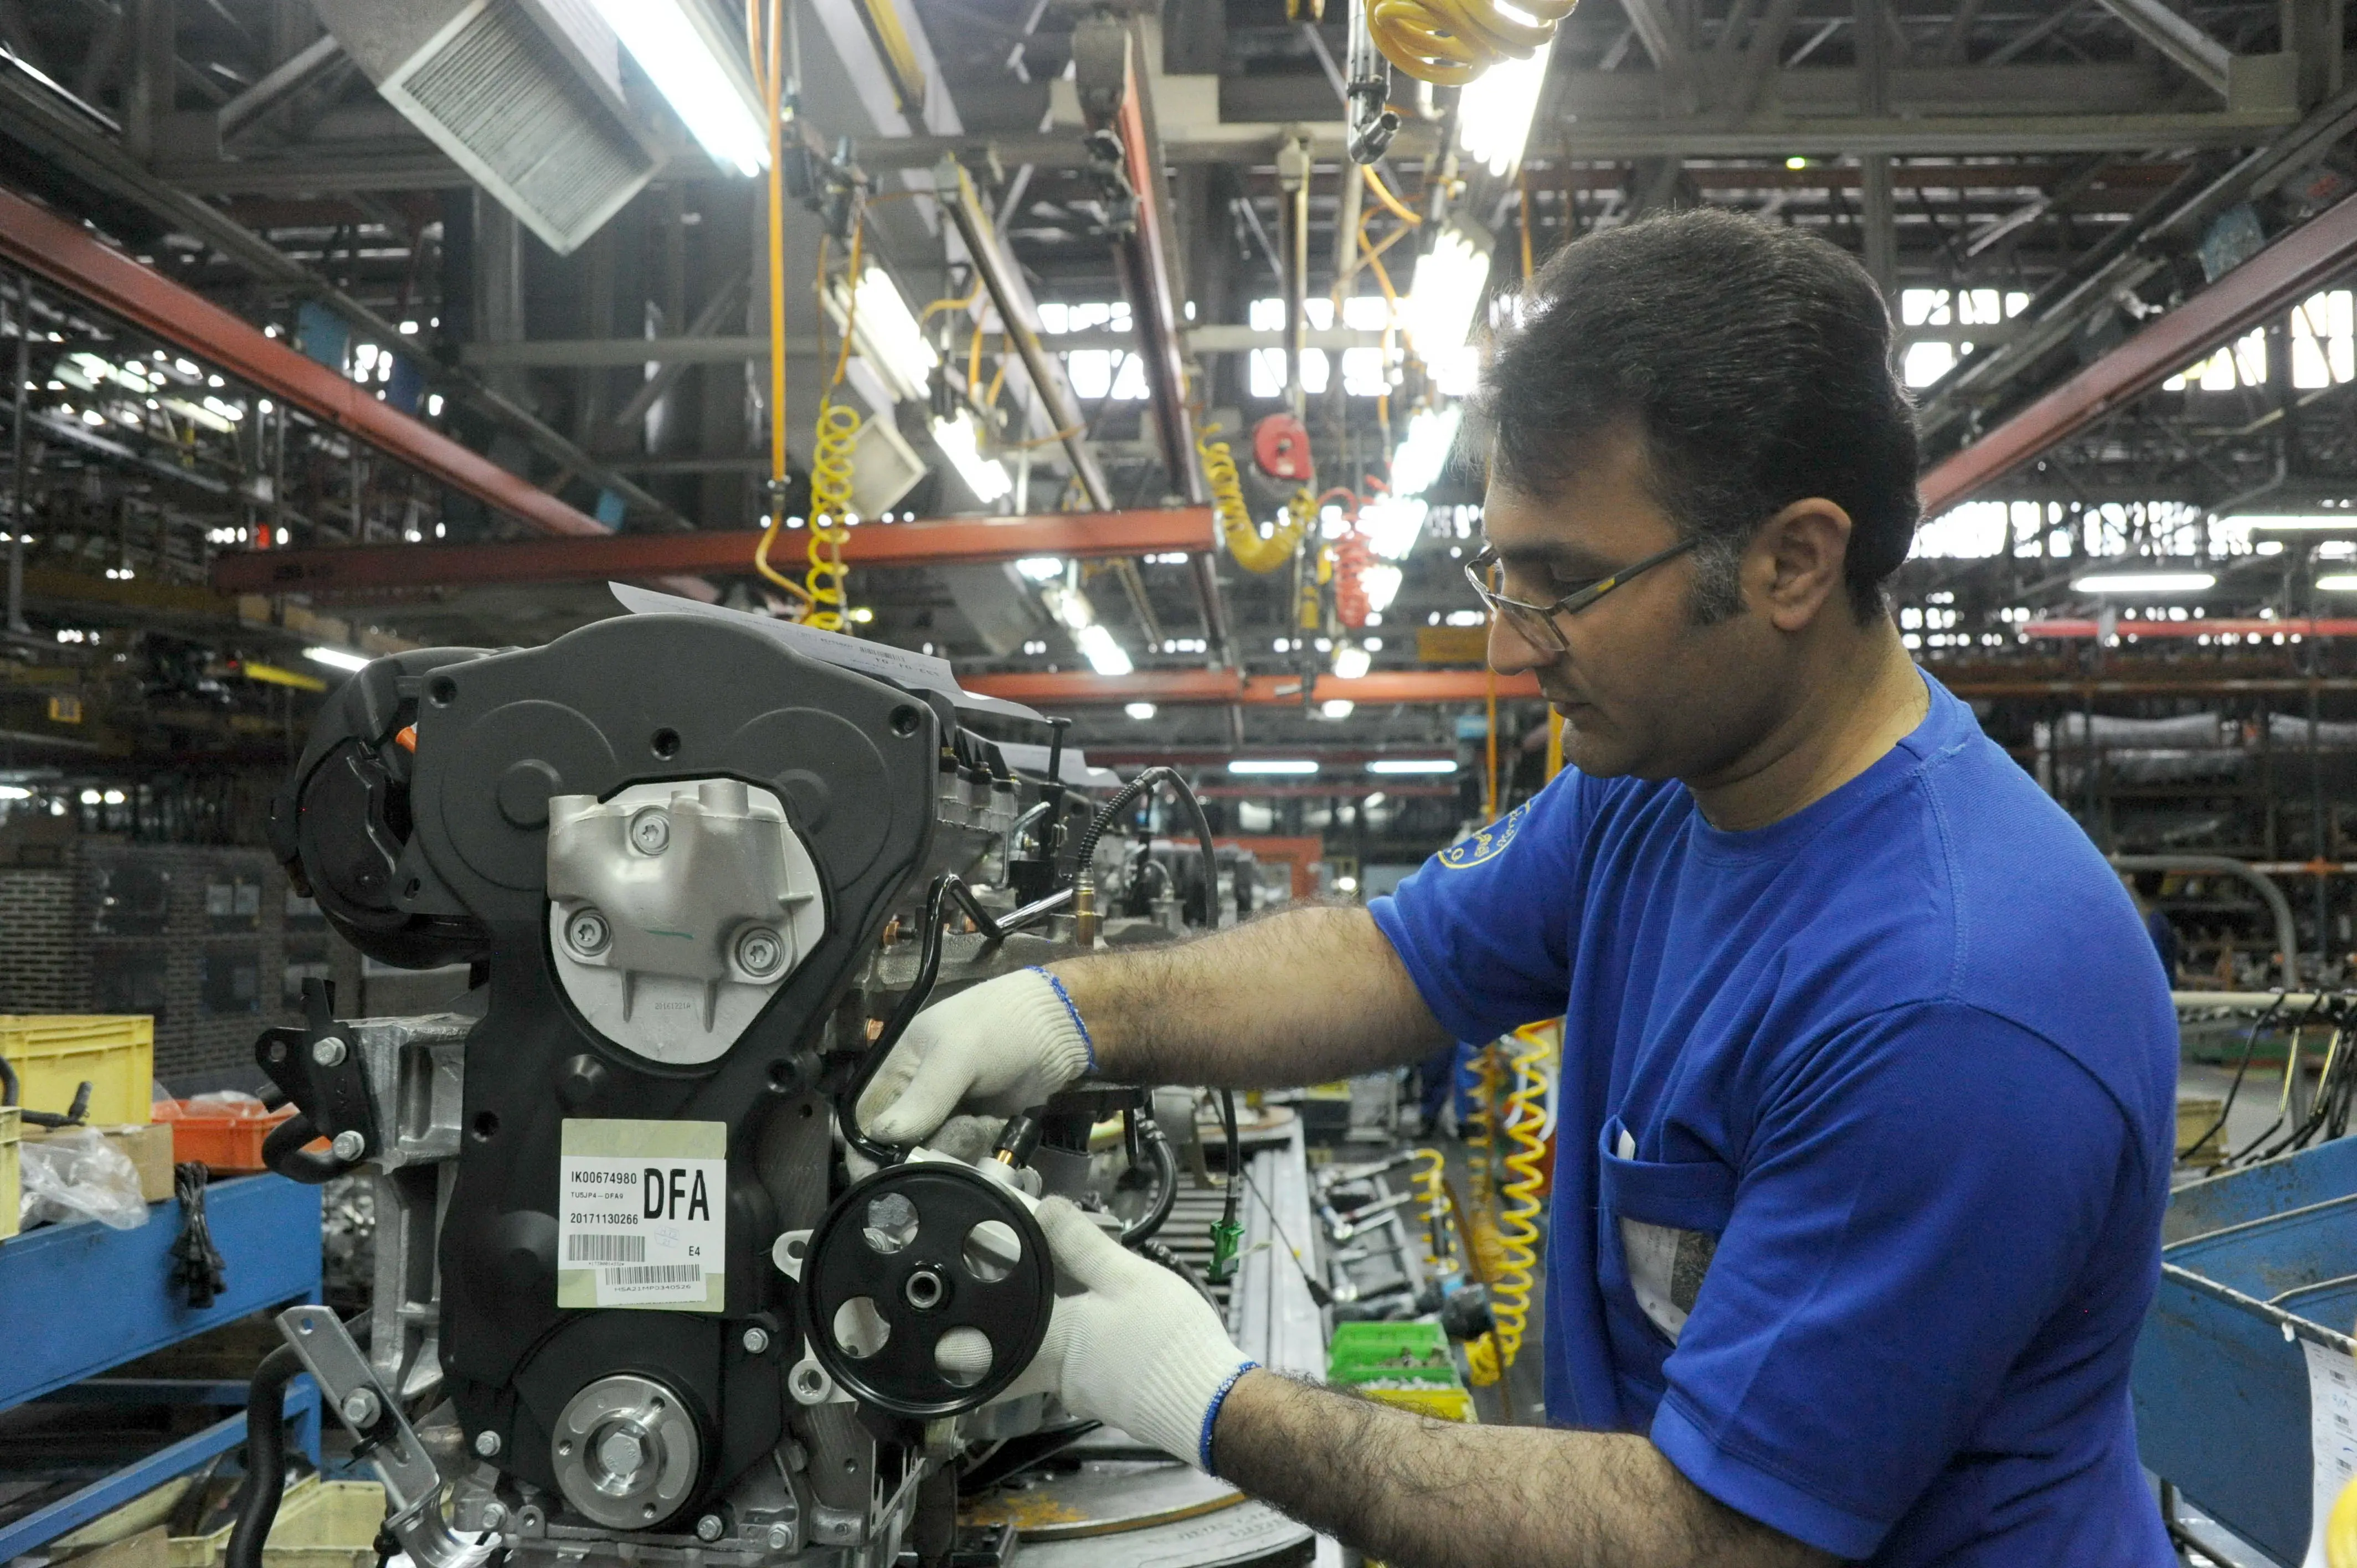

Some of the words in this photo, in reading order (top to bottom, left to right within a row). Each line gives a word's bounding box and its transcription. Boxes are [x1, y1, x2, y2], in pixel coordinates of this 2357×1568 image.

[572, 1171, 637, 1184] IK00674980
[644, 1168, 709, 1221] DFA
[570, 1213, 638, 1225] 20171130266
[688, 1246, 701, 1256] E4
